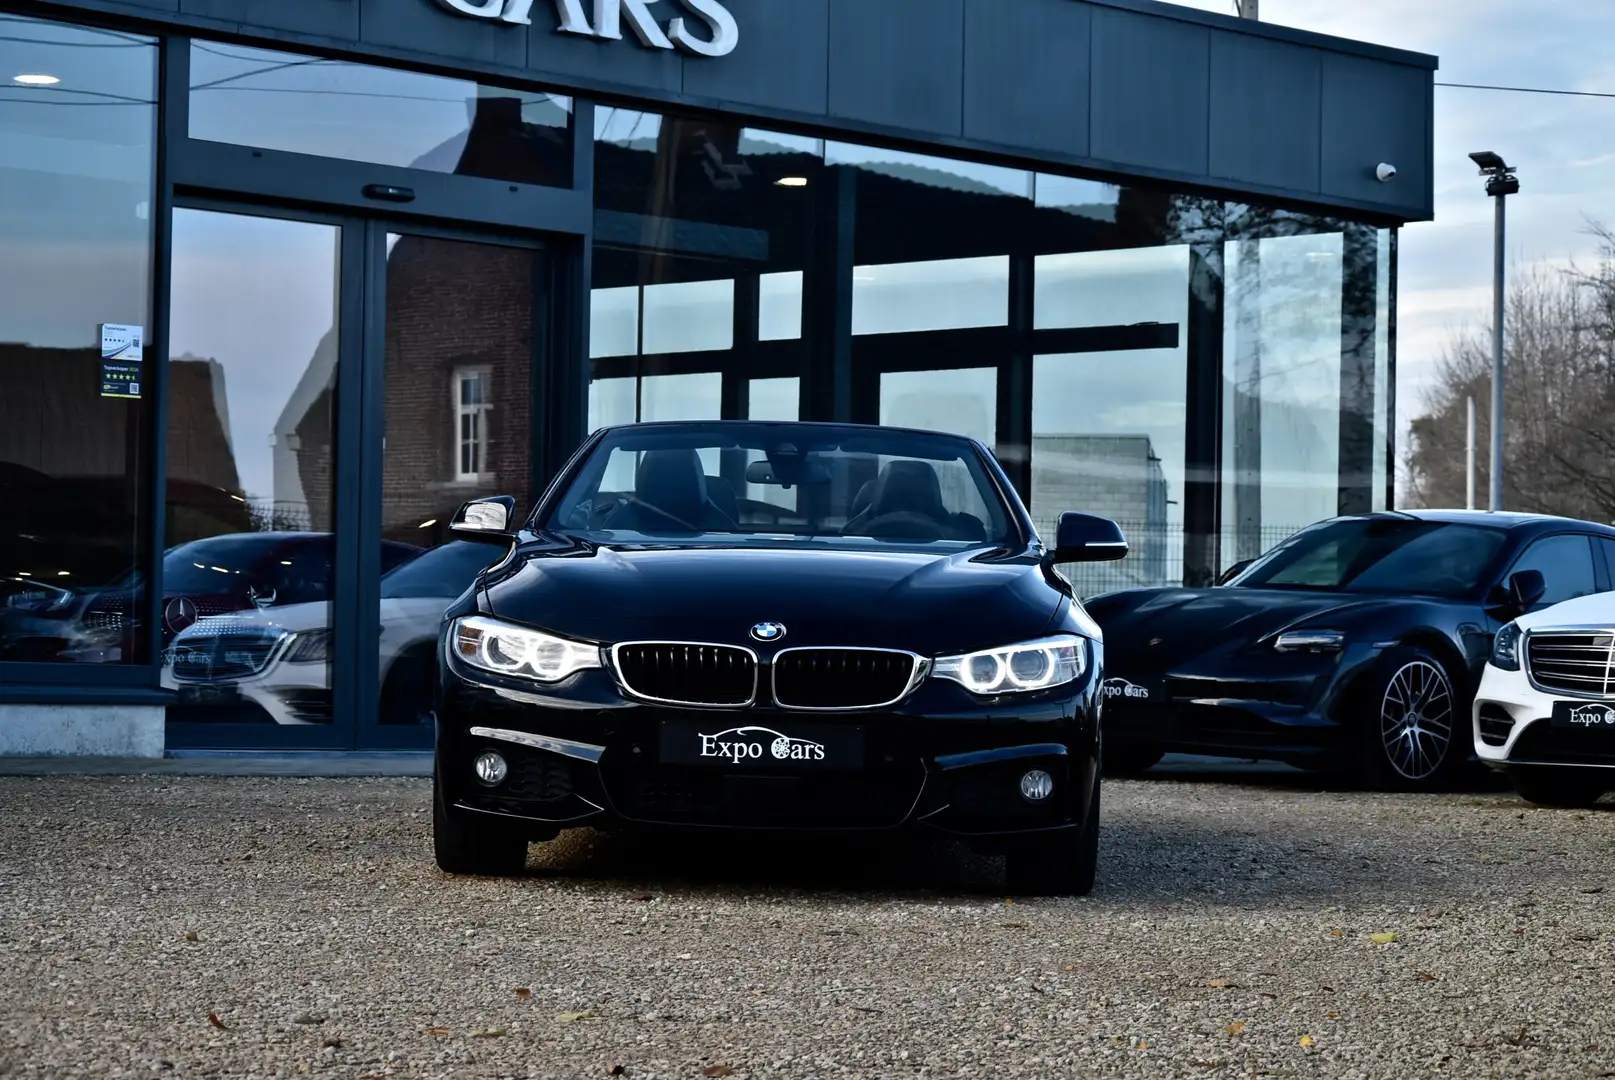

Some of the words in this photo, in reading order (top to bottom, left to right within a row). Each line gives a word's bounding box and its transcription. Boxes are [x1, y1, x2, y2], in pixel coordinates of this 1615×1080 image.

[1104, 685, 1122, 699] xpo
[1124, 684, 1149, 699] Cars
[1569, 708, 1601, 727] Expo
[698, 732, 763, 764] Expo
[771, 737, 826, 760] Cars
